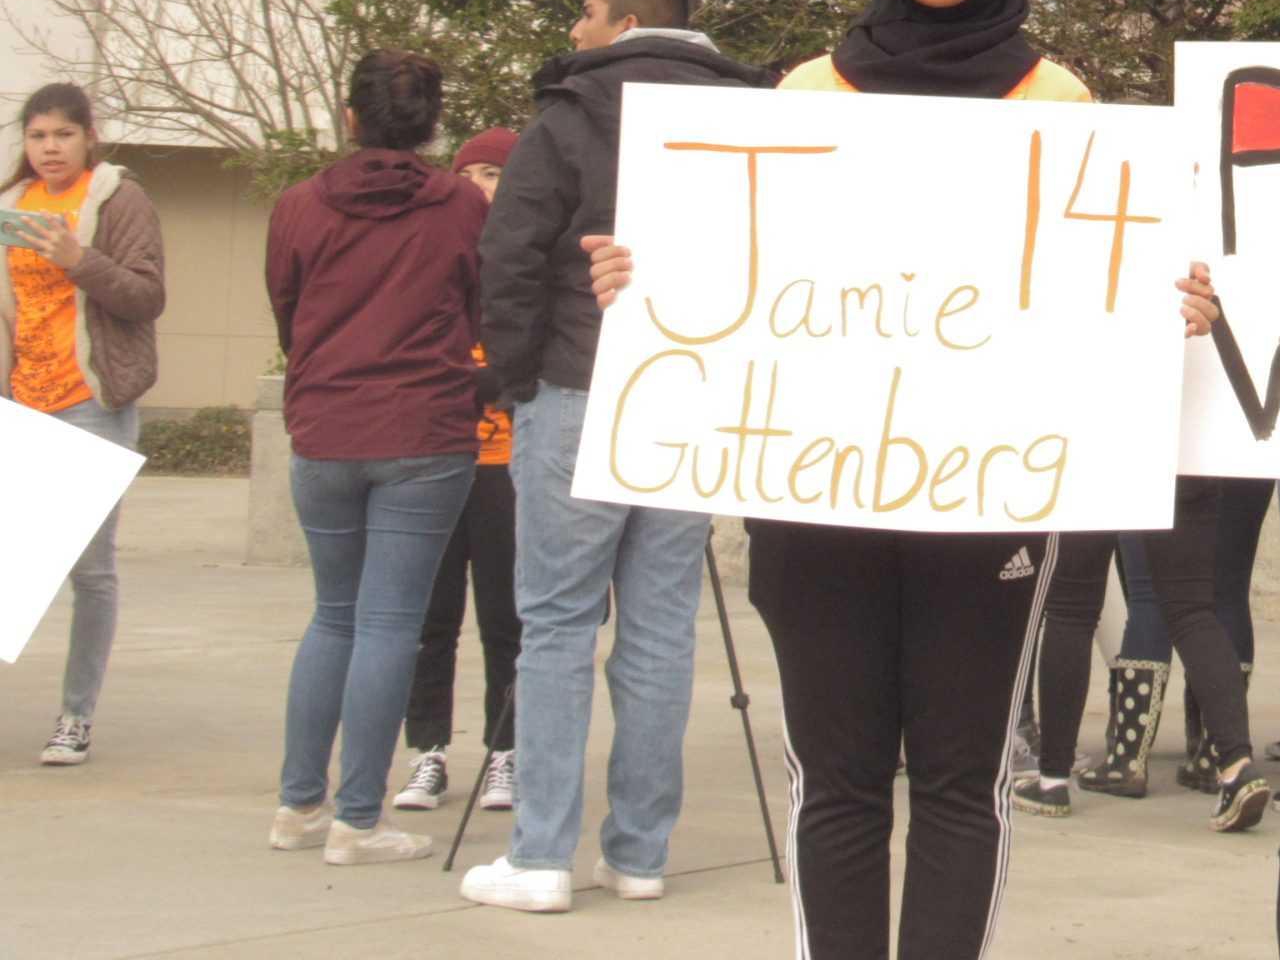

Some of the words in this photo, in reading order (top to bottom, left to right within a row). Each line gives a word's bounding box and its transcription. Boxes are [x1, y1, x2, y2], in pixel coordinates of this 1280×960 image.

[646, 141, 992, 350] Jamie
[1018, 128, 1163, 313] 14
[609, 348, 1068, 523] Guttenberg
[999, 565, 1035, 580] adidas
